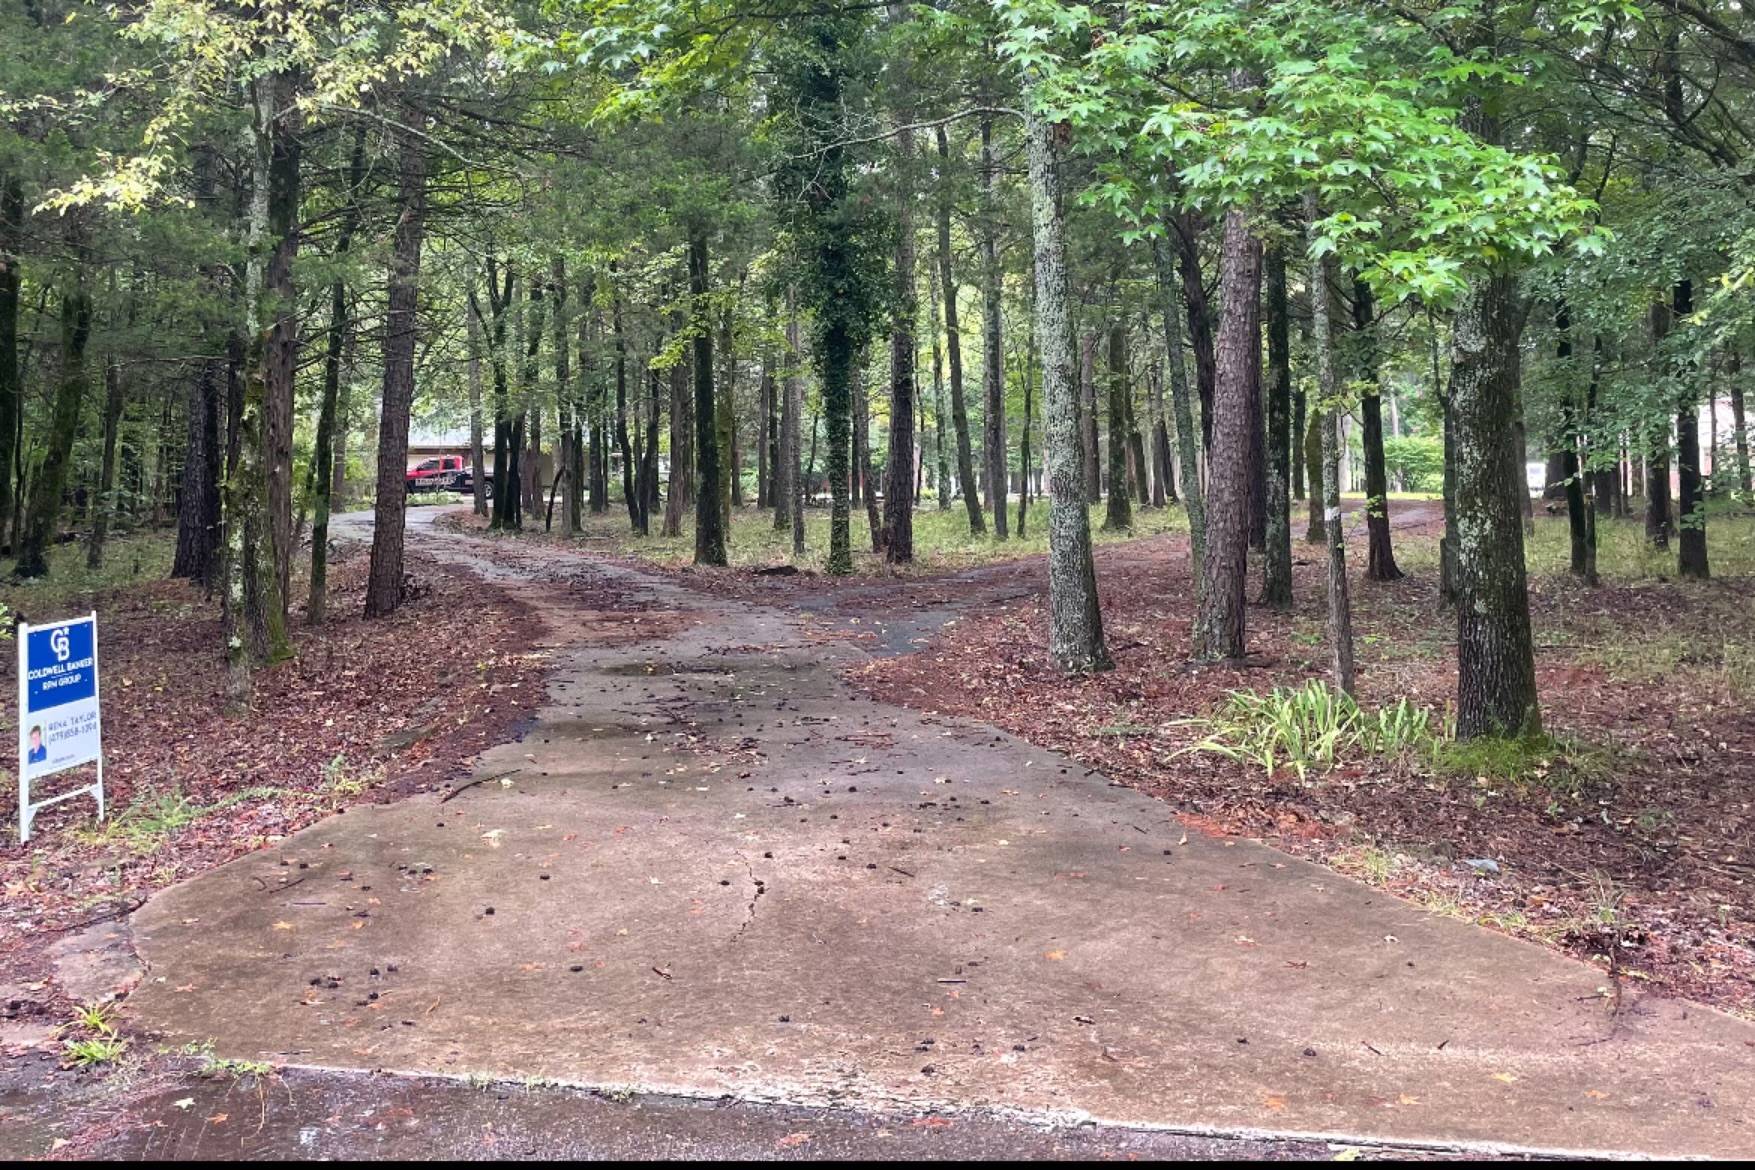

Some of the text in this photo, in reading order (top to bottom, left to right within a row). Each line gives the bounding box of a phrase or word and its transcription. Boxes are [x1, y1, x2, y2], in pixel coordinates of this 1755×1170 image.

[28, 657, 94, 680] COLDWELL BANKER
[58, 673, 82, 686] GROUP
